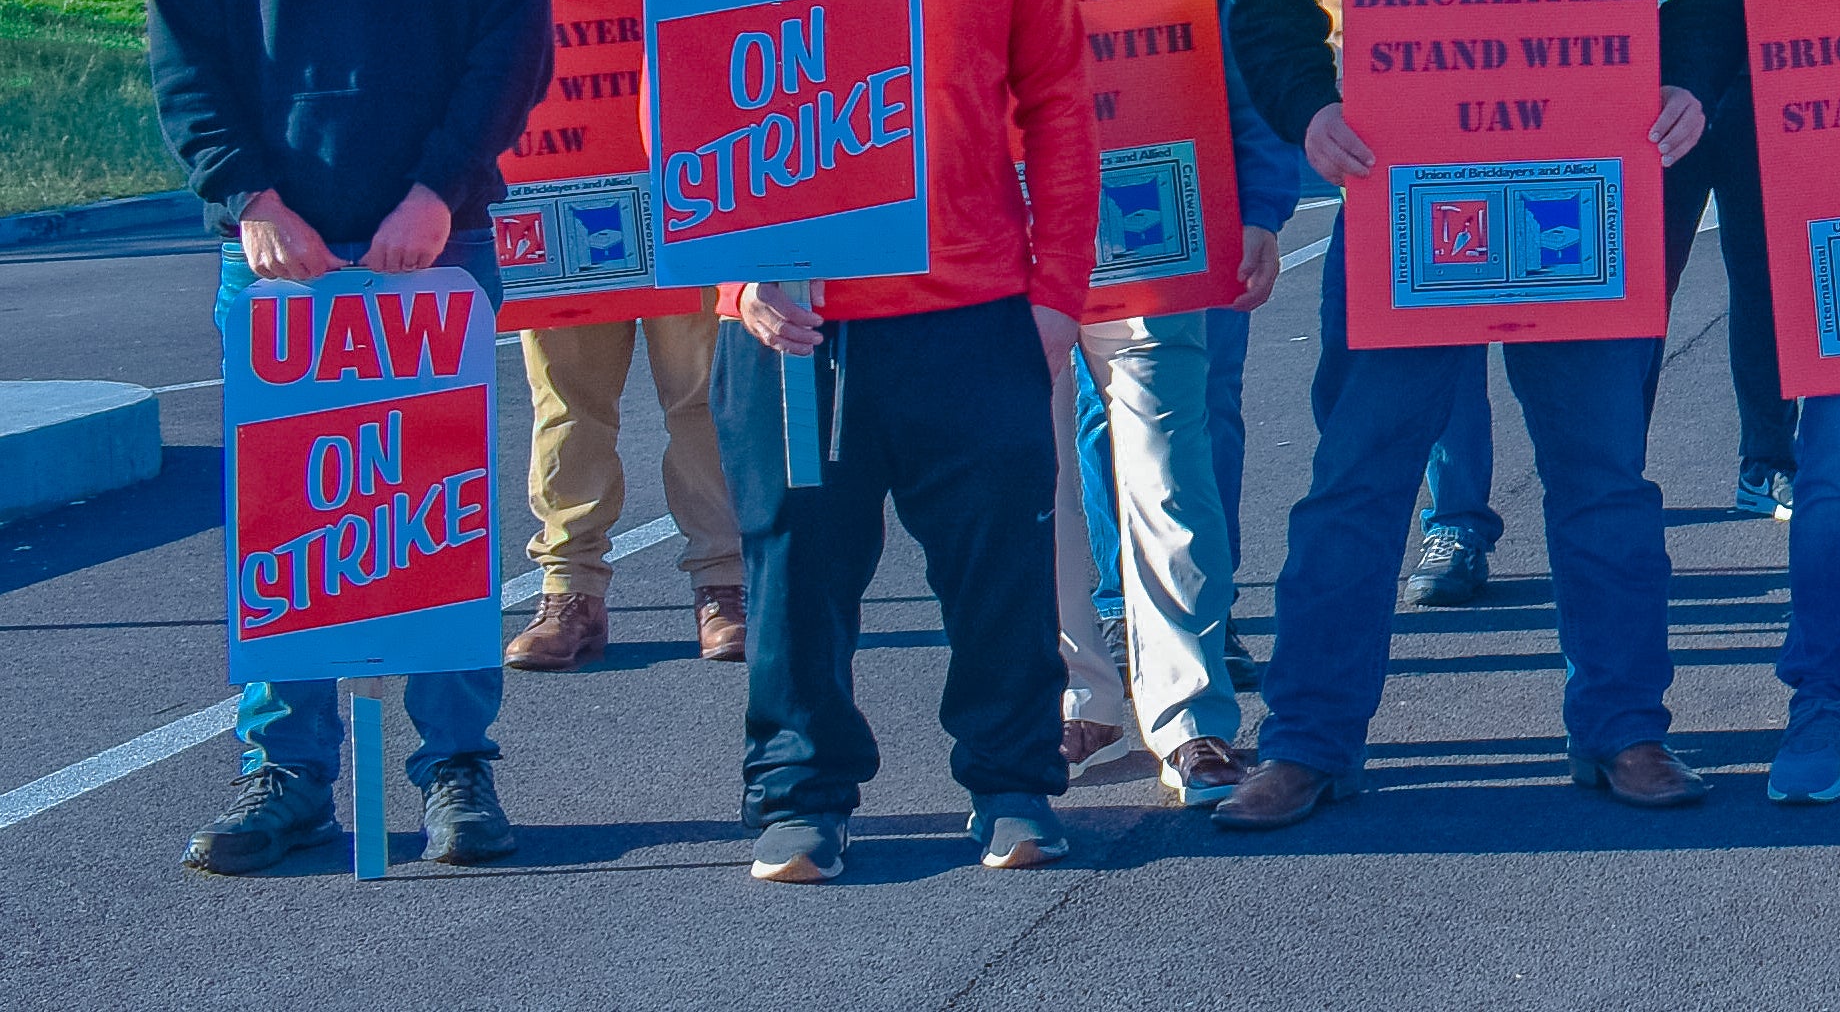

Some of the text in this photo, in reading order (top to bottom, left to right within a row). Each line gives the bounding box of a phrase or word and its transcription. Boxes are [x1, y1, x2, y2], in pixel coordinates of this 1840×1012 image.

[730, 5, 826, 111] ON
[1087, 22, 1196, 62] WITH
[1370, 34, 1632, 73] STAND WITH
[662, 65, 914, 234] STRIKE
[1456, 99, 1550, 132] UAW
[1415, 164, 1597, 180] Union of Bricklayers and Allied
[1396, 192, 1406, 284] International
[1606, 183, 1617, 278] Craftworkers
[1815, 245, 1834, 334] International
[249, 291, 476, 386] UAW
[307, 410, 403, 513] ON
[239, 468, 488, 630] STRIKE
